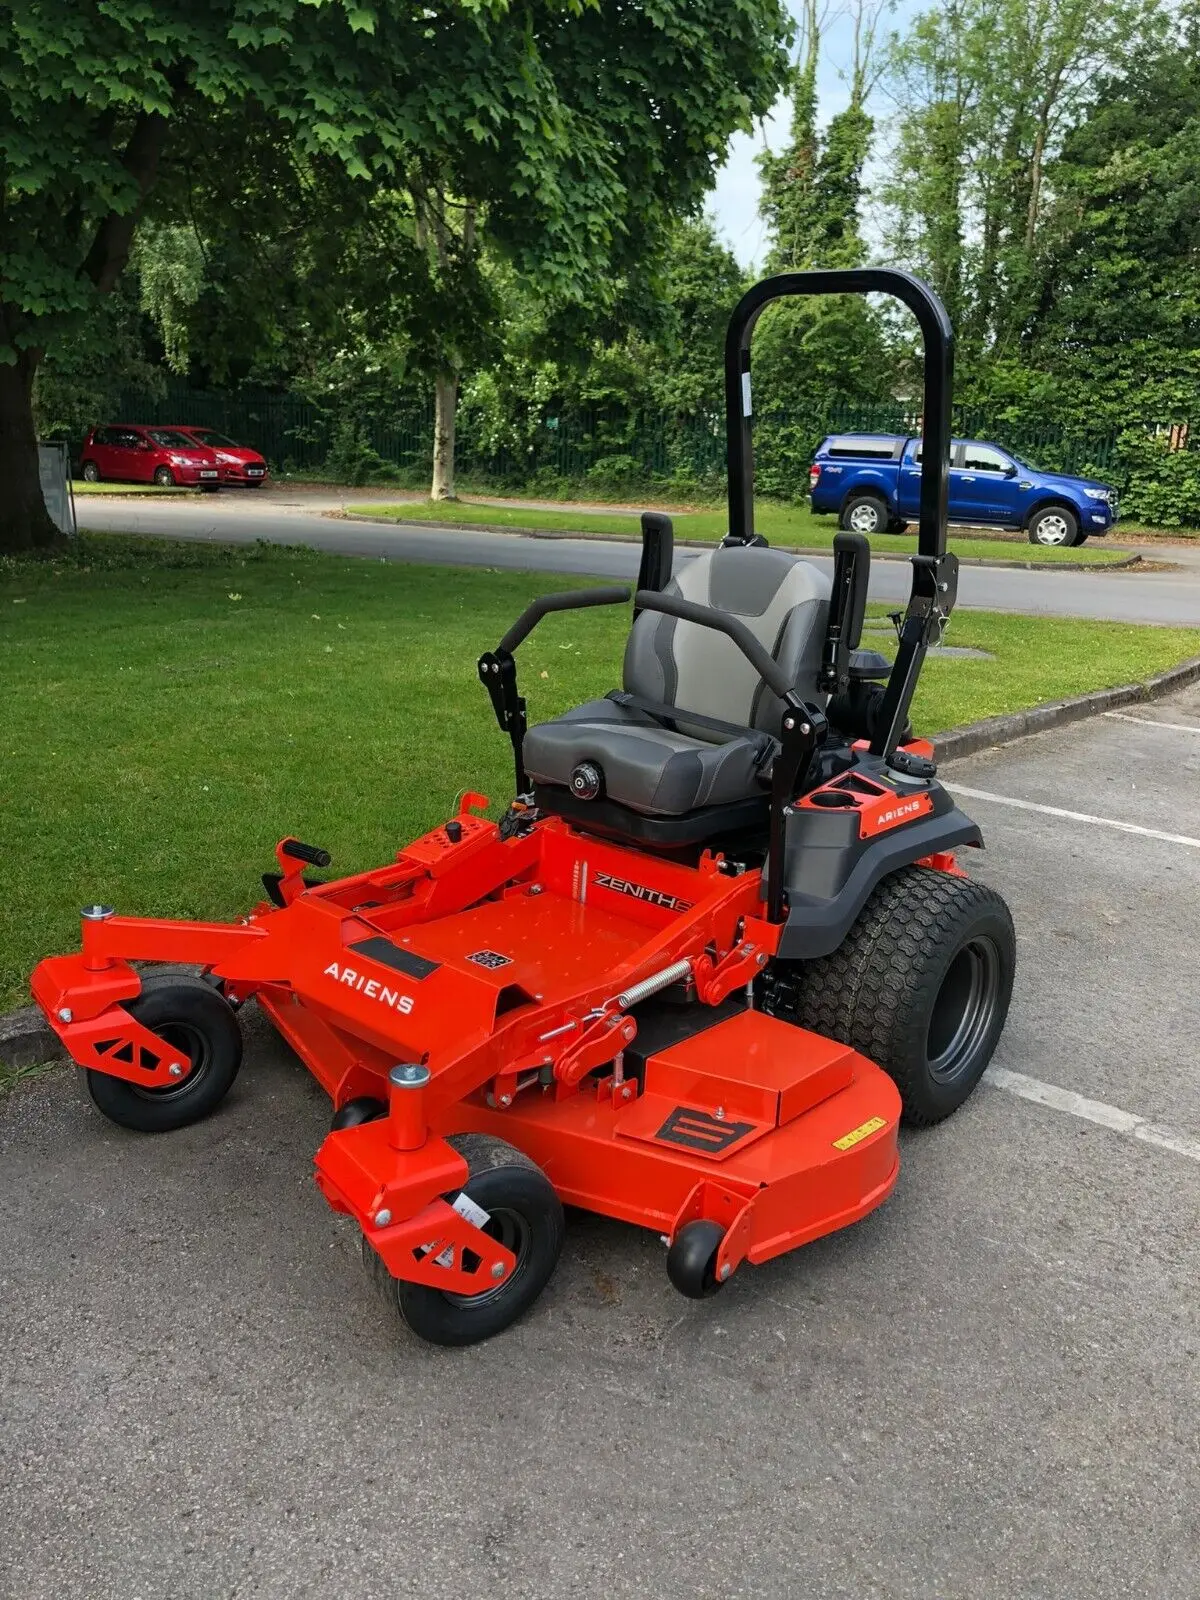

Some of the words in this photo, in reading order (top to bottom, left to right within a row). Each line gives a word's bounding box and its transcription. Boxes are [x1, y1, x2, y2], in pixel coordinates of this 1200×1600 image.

[877, 800, 920, 825] ARIENS
[595, 872, 676, 909] ZENITH
[323, 961, 415, 1015] ARIENS
